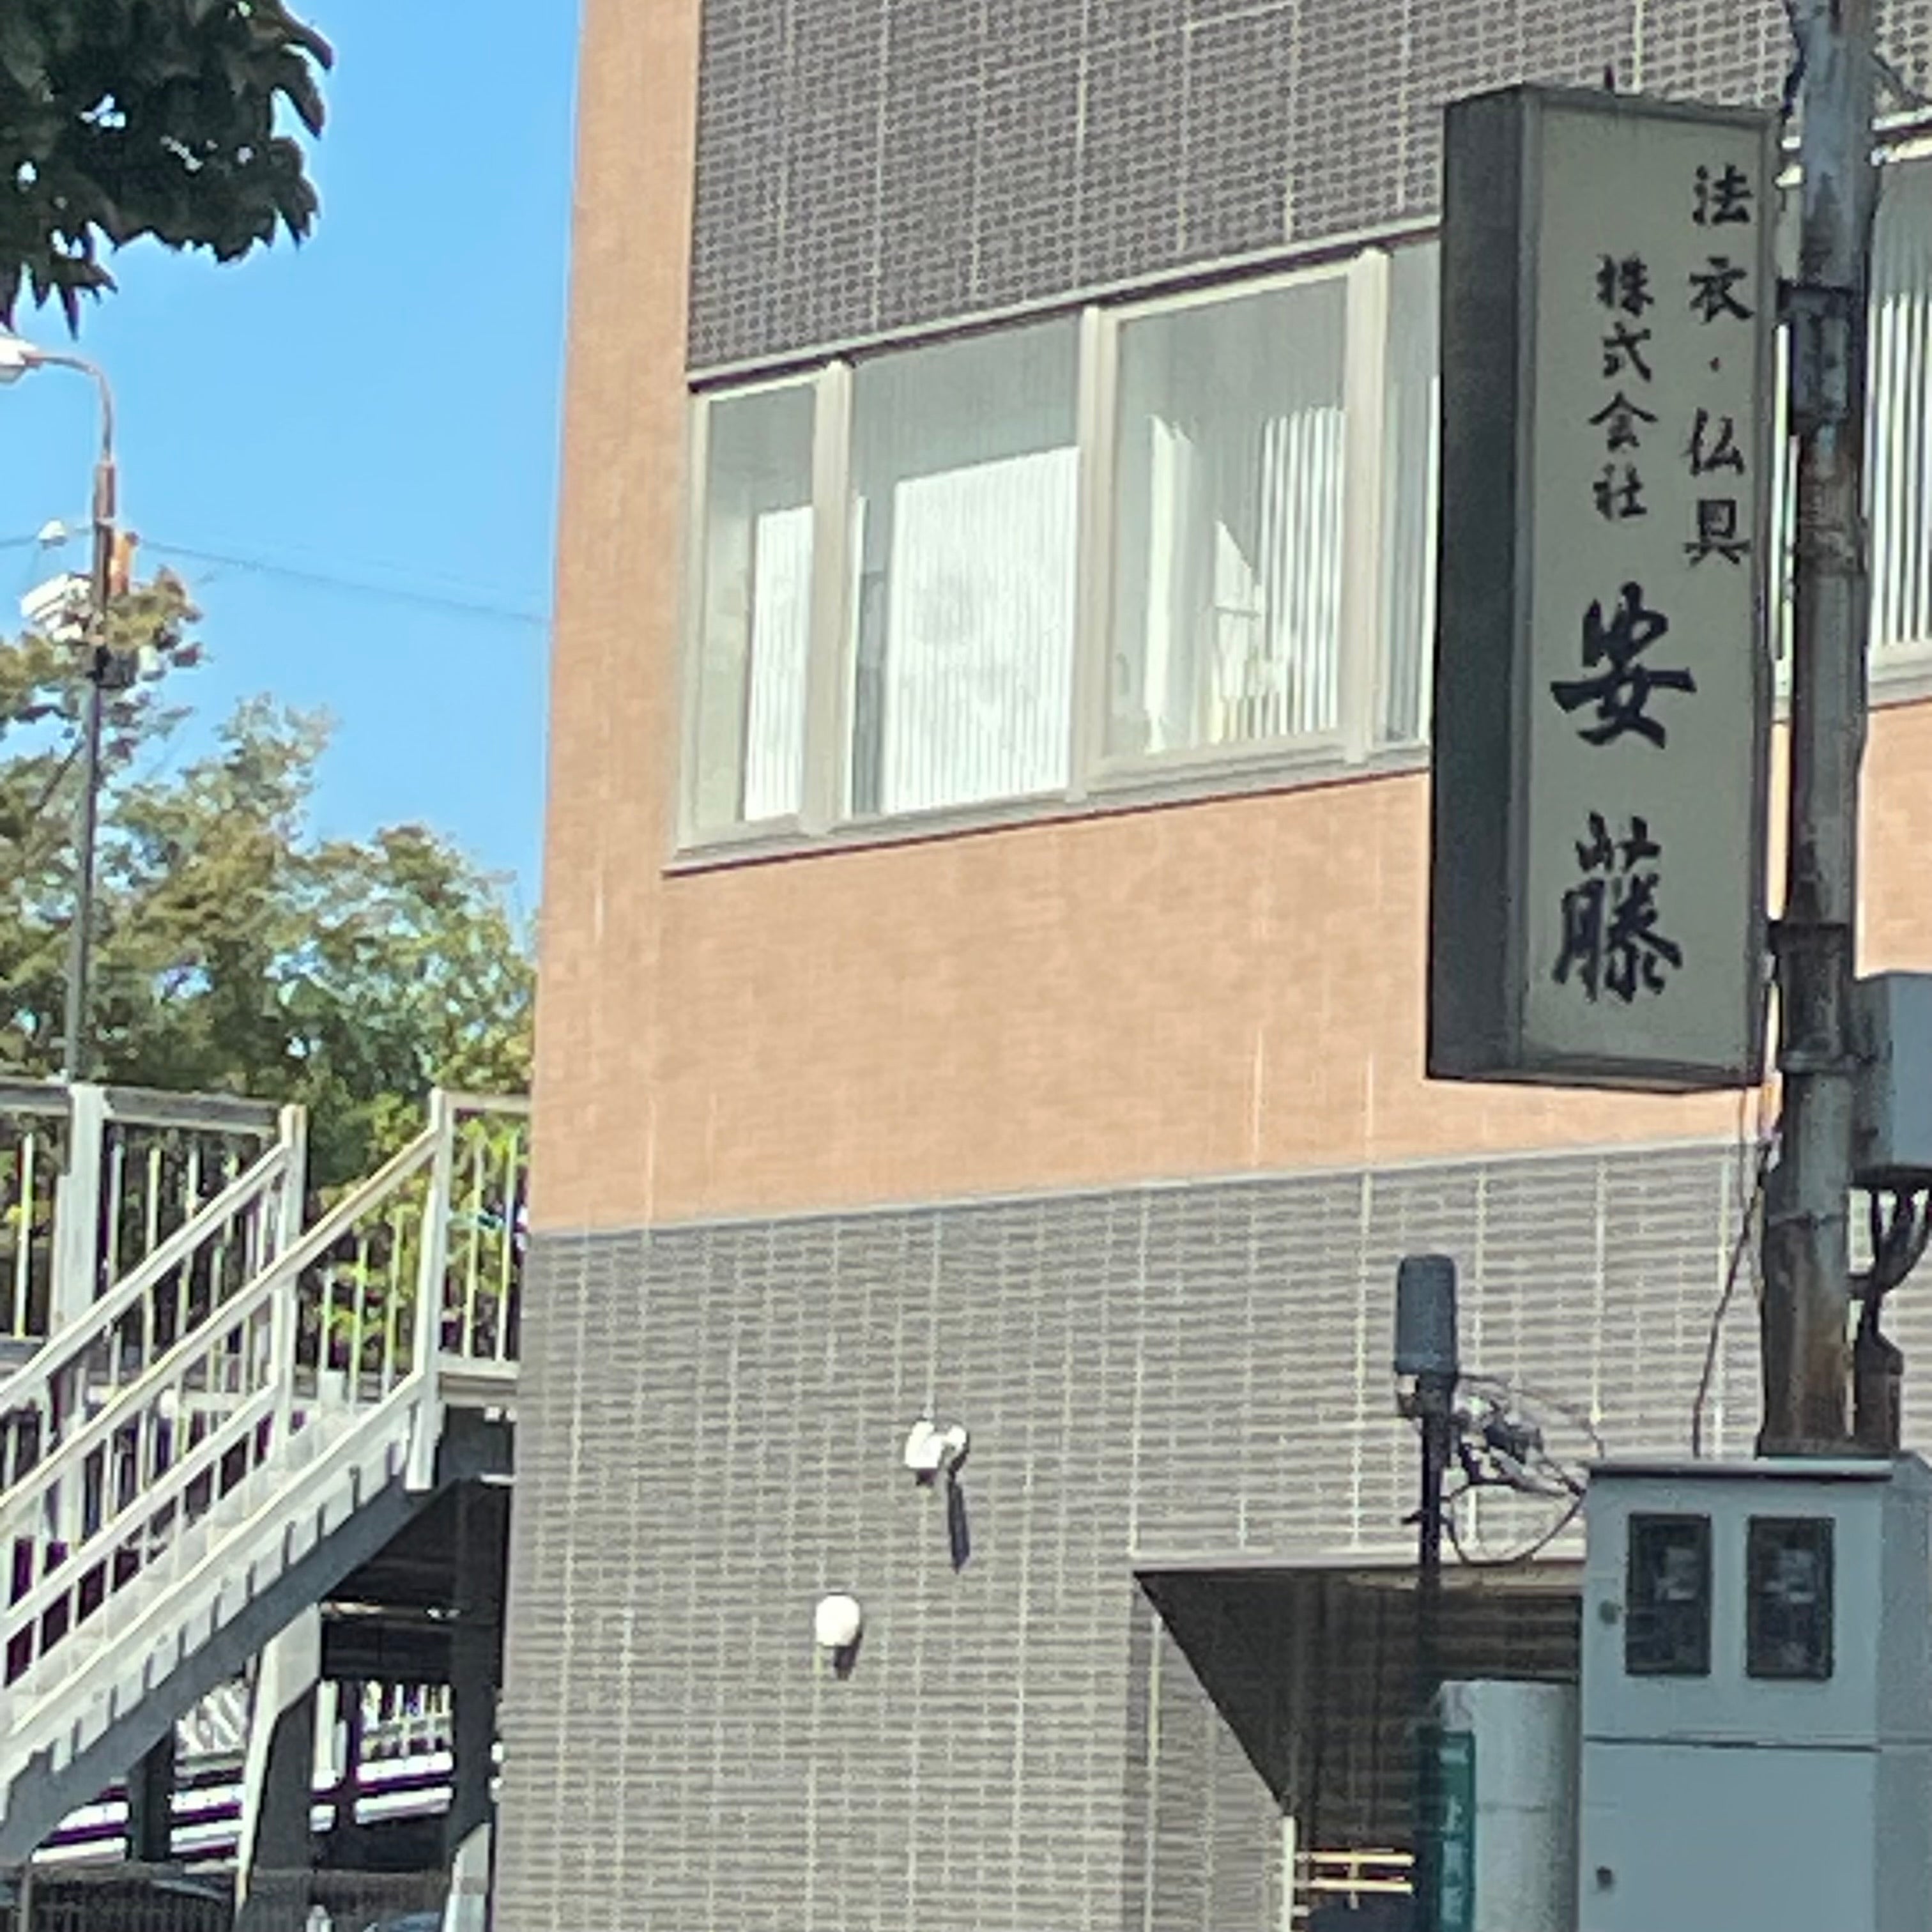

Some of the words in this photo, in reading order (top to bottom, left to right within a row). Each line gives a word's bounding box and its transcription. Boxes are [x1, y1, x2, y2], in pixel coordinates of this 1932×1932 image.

[1683, 164, 1754, 565] 法衣・仏具
